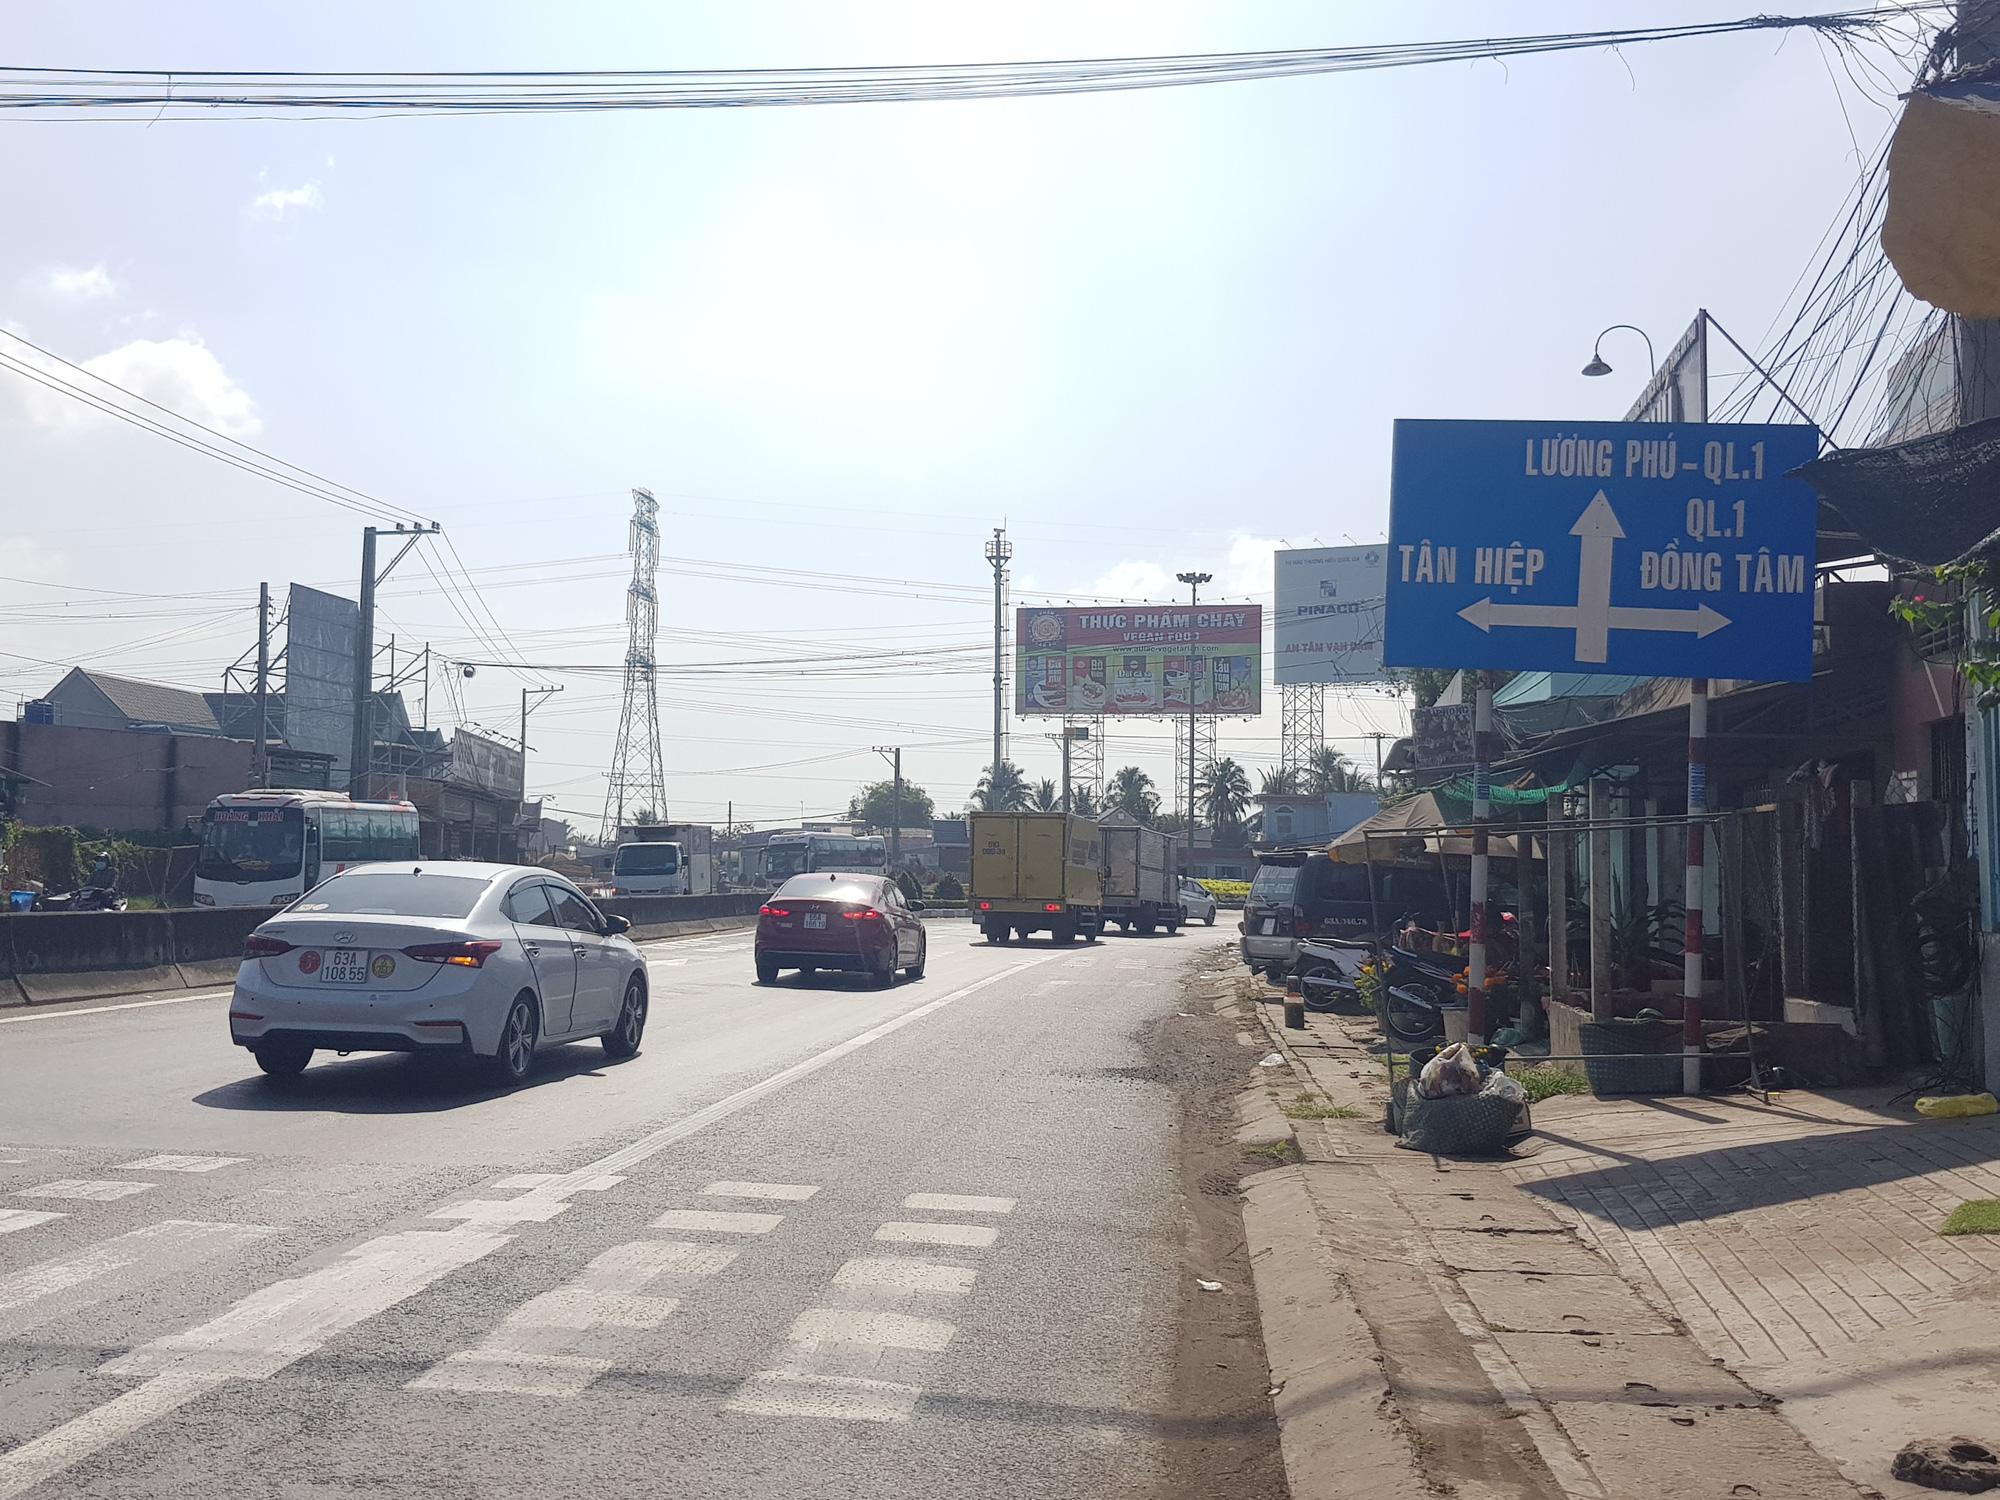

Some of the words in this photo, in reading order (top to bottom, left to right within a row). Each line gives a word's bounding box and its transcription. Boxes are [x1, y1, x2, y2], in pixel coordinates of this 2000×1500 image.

[1525, 433, 1613, 478] LƯƠNG
[1625, 432, 1676, 480] PHÚ
[1703, 441, 1764, 485] QL.1
[1686, 498, 1745, 542] QL.1
[1398, 538, 1457, 584] TÂN
[1474, 541, 1545, 595] HIỆP
[1639, 537, 1722, 592] ĐỒNG
[1735, 546, 1805, 594] TÂM
[1079, 613, 1127, 631] THỰC
[1134, 609, 1188, 628] PHẨM
[1197, 612, 1245, 628] CHAY
[1297, 603, 1359, 616] PINACO
[1123, 632, 1165, 642] VEGAN
[333, 952, 357, 966] 63A
[325, 966, 365, 980] 108.55
